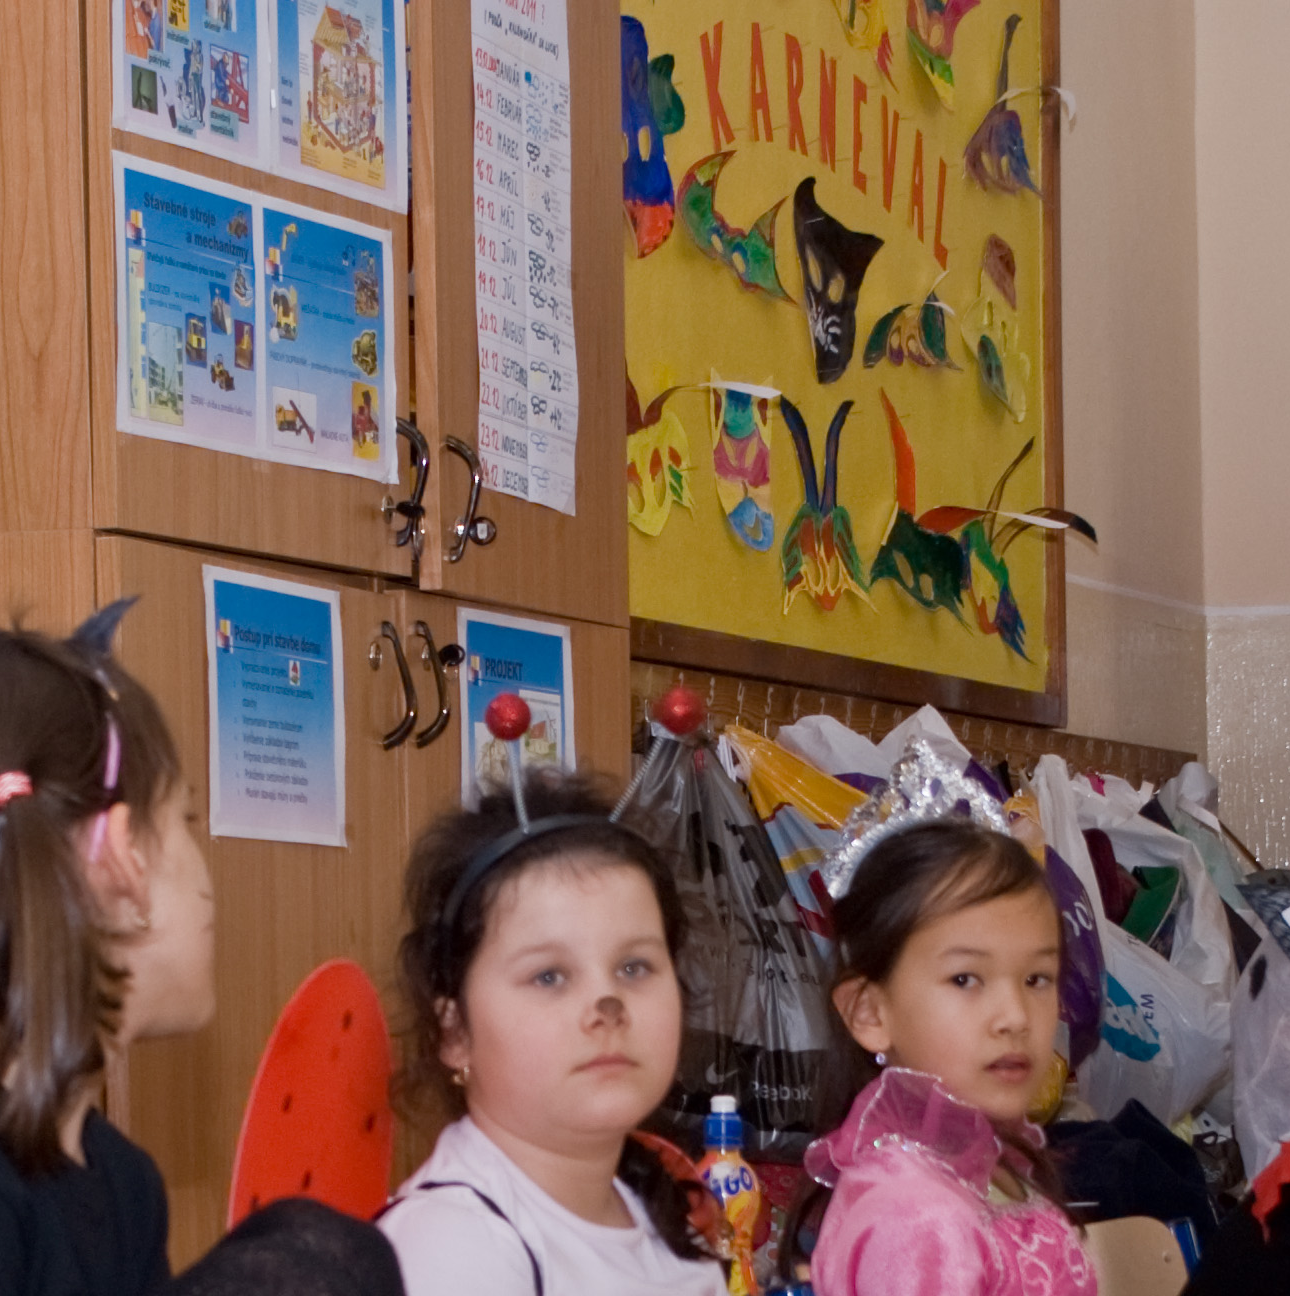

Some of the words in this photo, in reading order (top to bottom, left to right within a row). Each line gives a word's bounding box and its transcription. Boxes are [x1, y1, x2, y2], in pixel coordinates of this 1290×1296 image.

[700, 20, 949, 271] KARNEVAL
[143, 191, 188, 219] Stavebné
[189, 206, 217, 229] stroje
[186, 231, 193, 244] a
[193, 232, 250, 263] mechanizmy
[234, 623, 262, 649] Postup
[262, 629, 274, 650] pri
[274, 633, 301, 652] stavbe
[485, 657, 524, 682] PROJEKT
